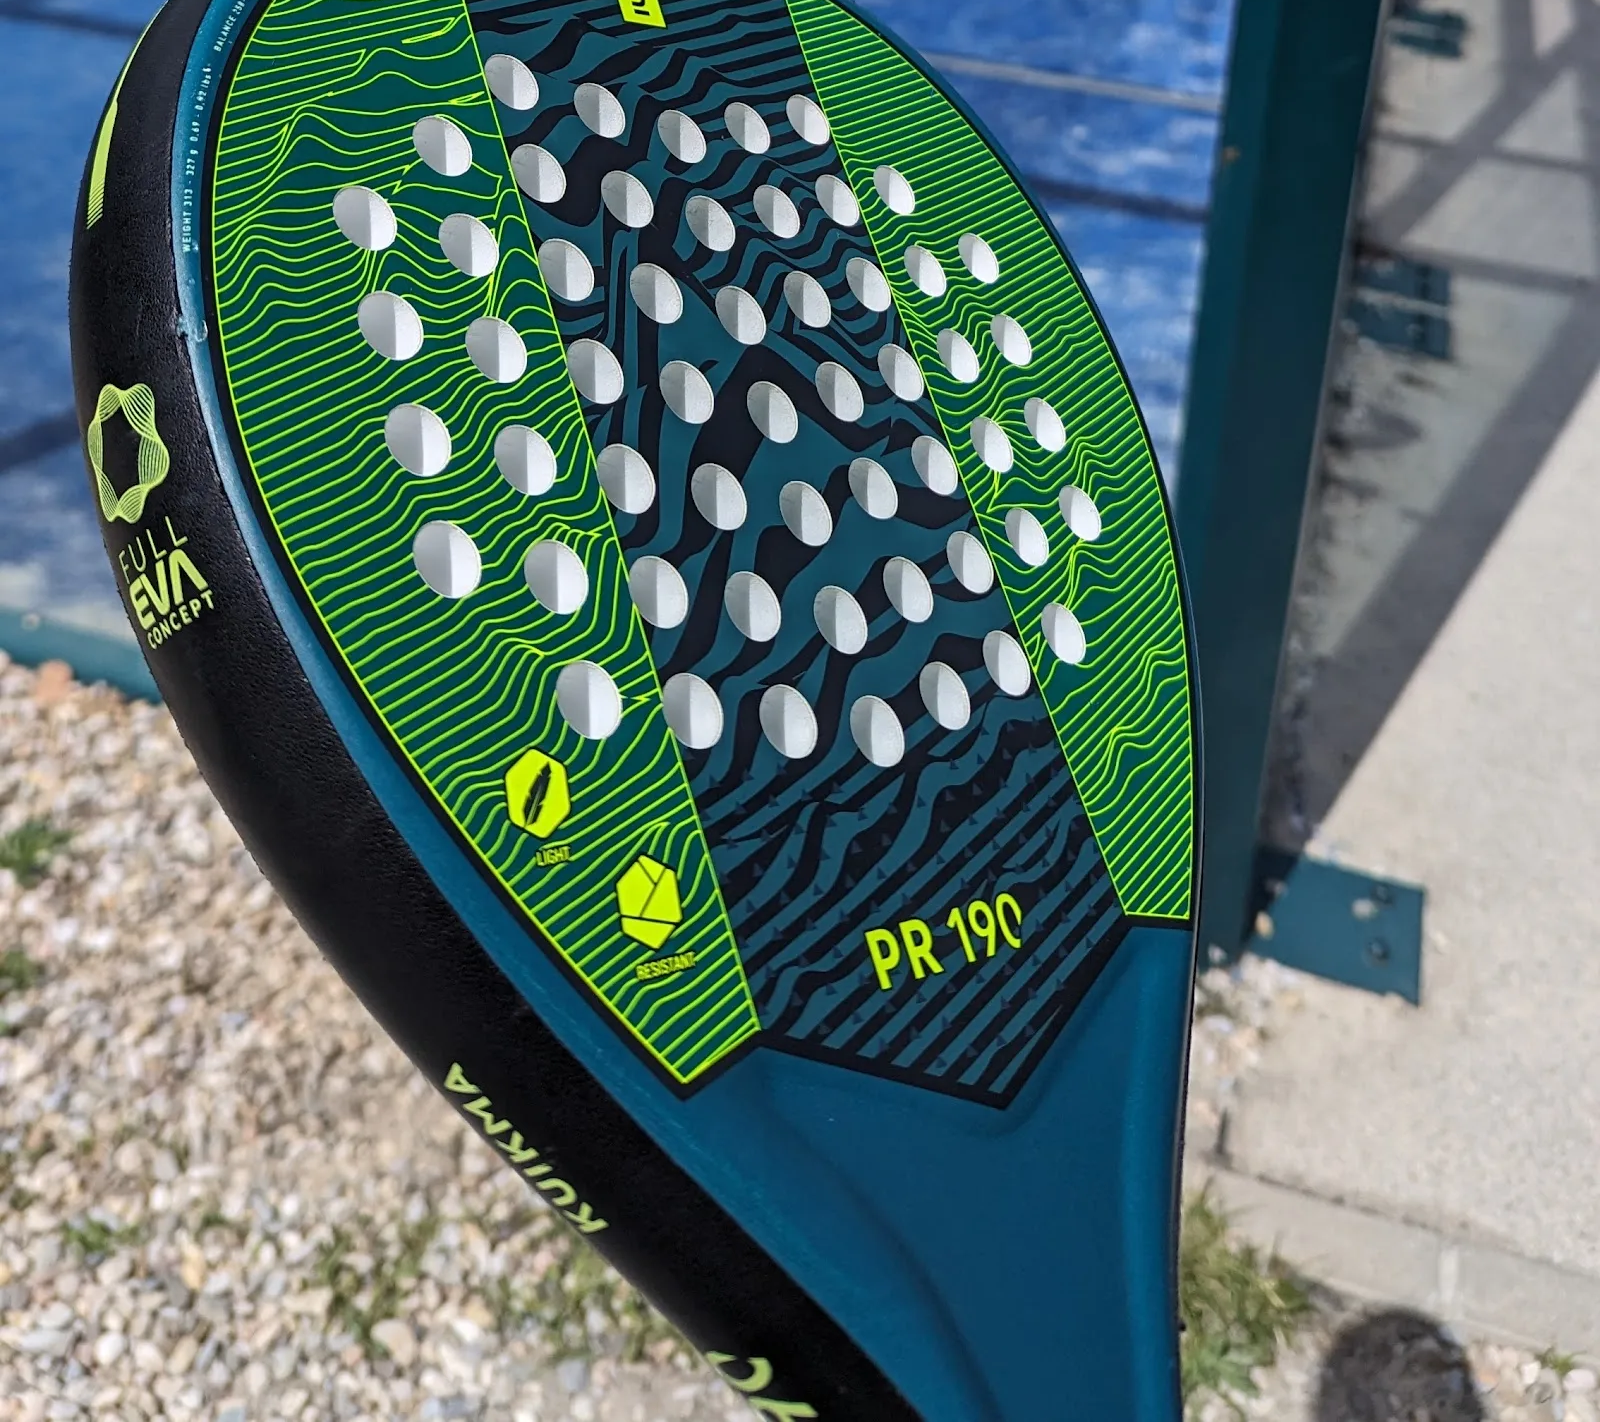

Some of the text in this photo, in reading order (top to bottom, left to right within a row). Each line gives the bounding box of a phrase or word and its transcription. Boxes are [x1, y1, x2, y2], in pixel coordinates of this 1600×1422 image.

[213, 14, 237, 52] BALANCE
[189, 121, 201, 142] 0.69
[186, 158, 196, 176] 327
[183, 188, 193, 207] 313
[182, 210, 192, 253] WEIGHT
[118, 515, 188, 584] FULL
[129, 548, 209, 631] EVA
[147, 589, 215, 650] CONCEPT
[535, 845, 571, 867] LIGHT
[864, 893, 1022, 990] PR 190
[636, 951, 696, 980] RESISTANT
[444, 1062, 609, 1233] KUIKMA
